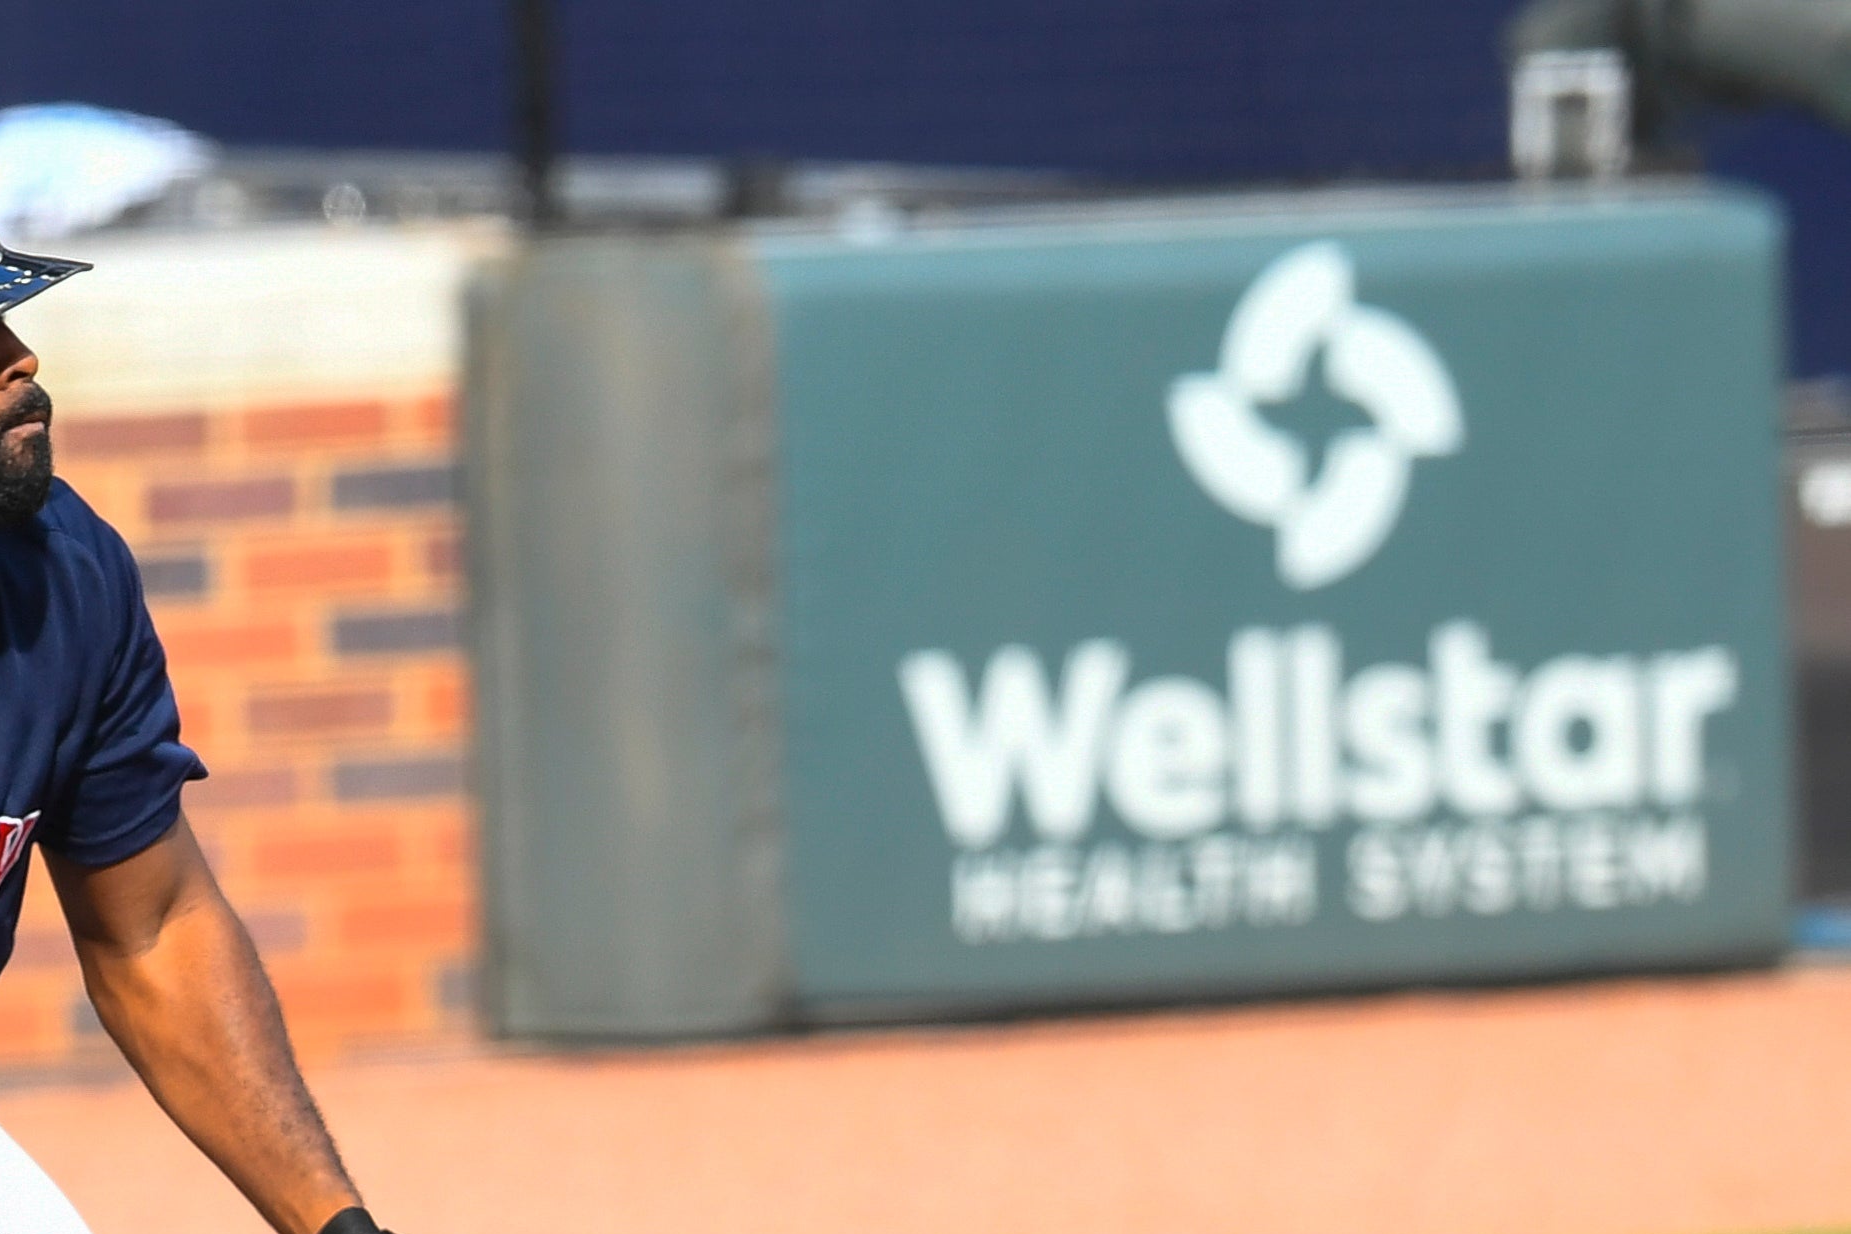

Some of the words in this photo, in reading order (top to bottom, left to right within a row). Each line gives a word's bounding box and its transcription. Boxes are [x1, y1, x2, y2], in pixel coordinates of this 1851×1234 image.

[900, 620, 1738, 846] Wellstar
[951, 834, 1317, 943] HEALTH
[1347, 815, 1707, 920] SYSTEM
